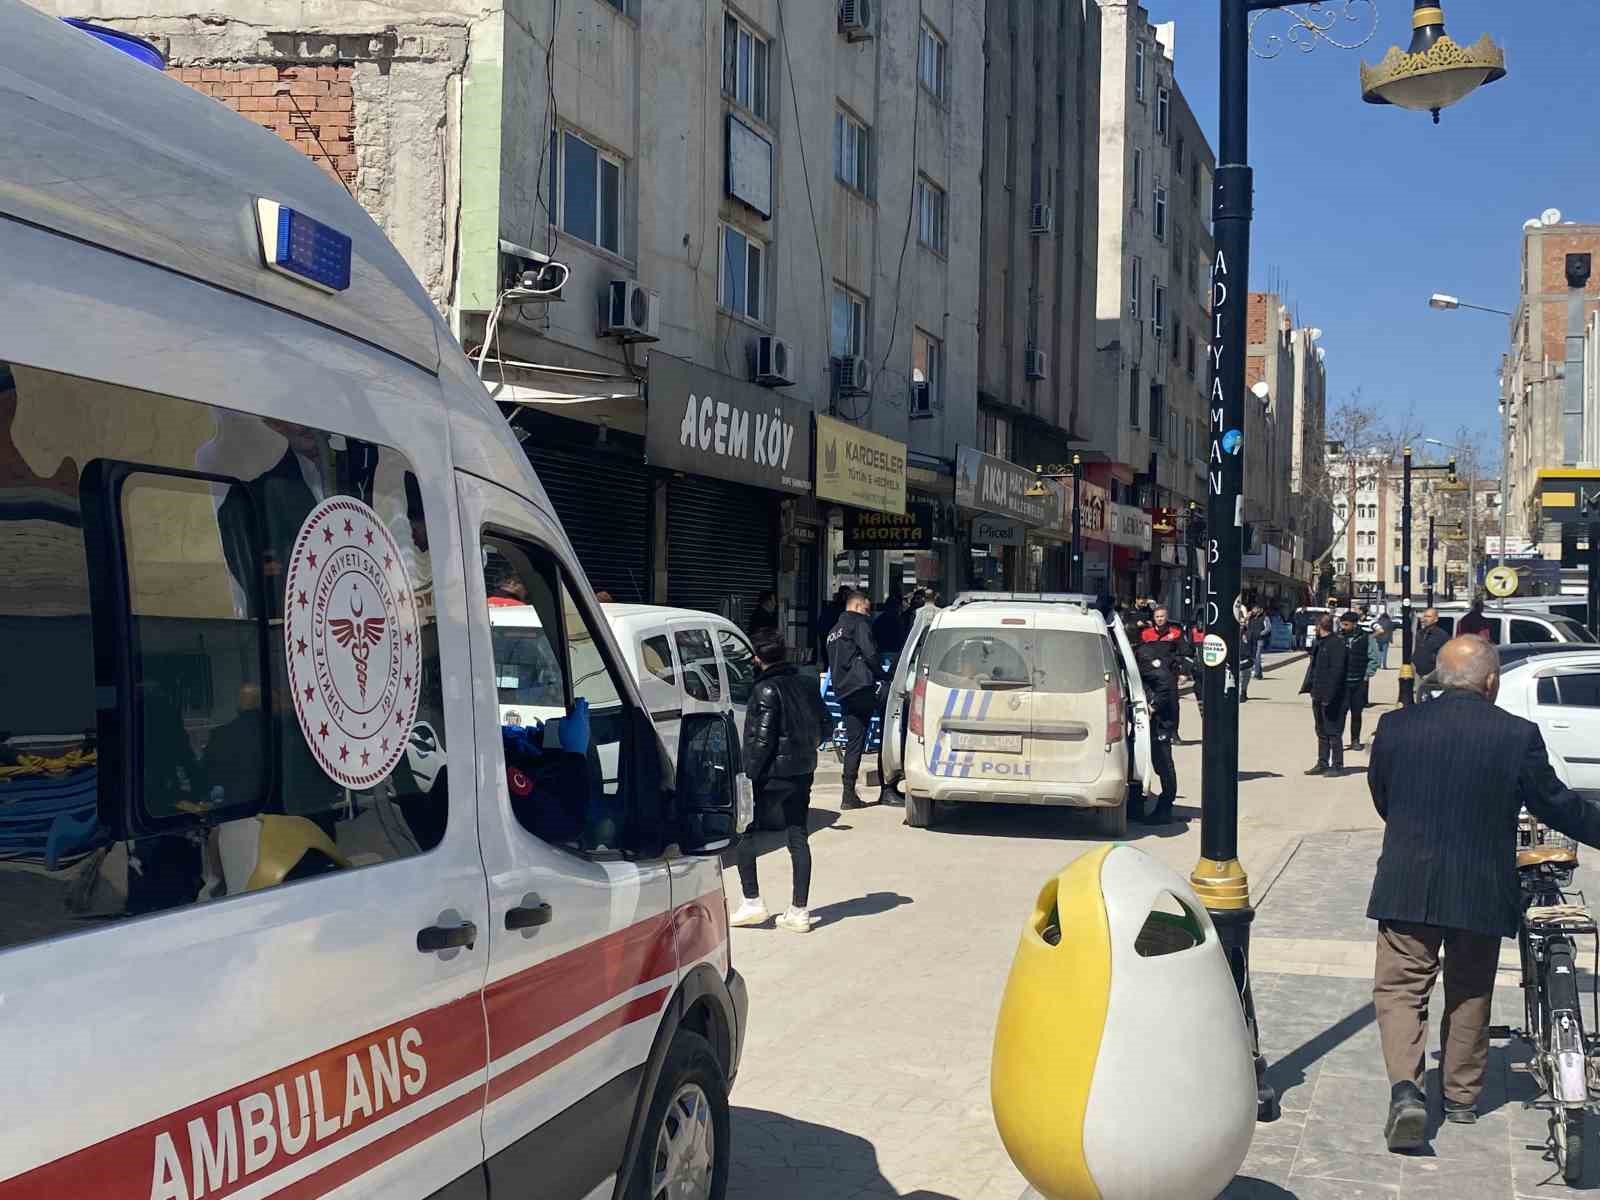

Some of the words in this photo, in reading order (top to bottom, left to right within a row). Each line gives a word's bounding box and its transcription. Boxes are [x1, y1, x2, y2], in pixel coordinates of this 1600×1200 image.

[1209, 250, 1228, 496] ADIYAMAN
[680, 393, 750, 461] ACEM
[753, 407, 795, 470] KÖY
[982, 464, 1007, 507] AKSA
[1206, 538, 1220, 626] BLD
[150, 1027, 428, 1200] AMBULANS
